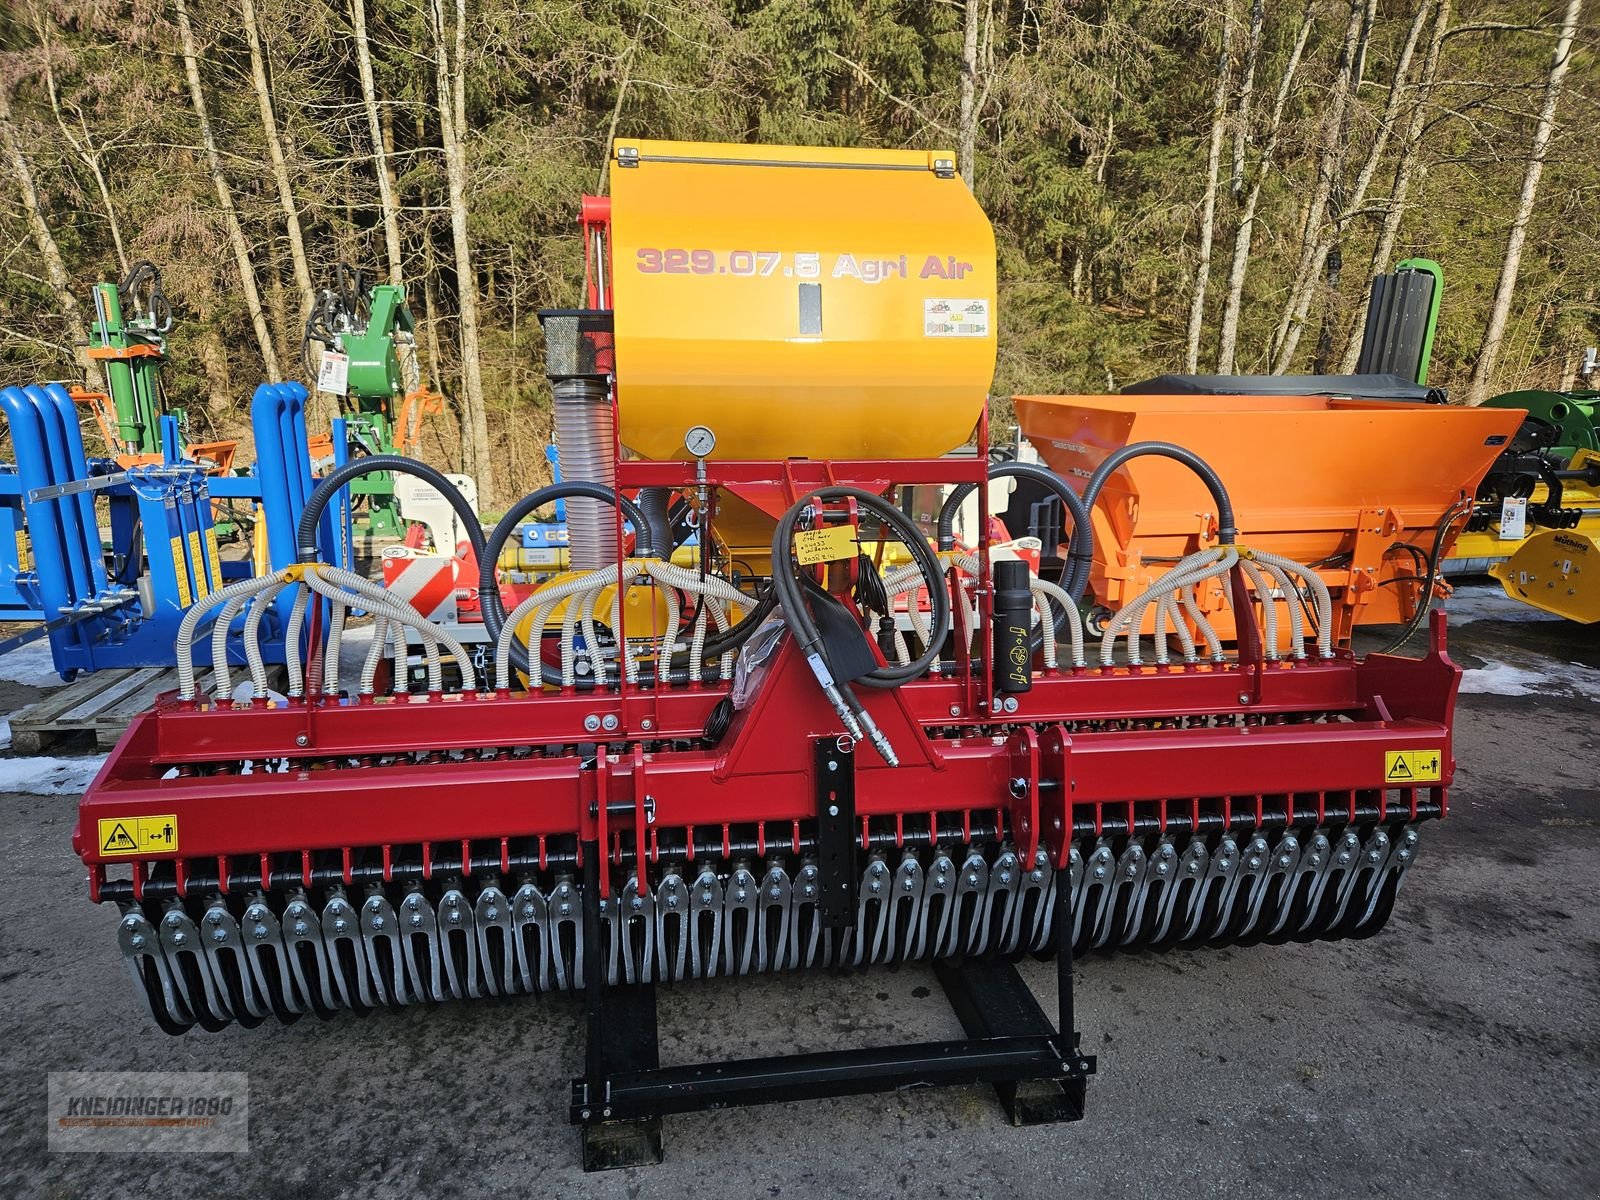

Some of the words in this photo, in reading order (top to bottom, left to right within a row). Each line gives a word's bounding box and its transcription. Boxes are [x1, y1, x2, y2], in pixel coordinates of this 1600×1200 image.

[636, 247, 821, 278] 329.07.5
[831, 252, 907, 284] Agri
[918, 254, 974, 281] Air
[1553, 534, 1589, 552] Müthing
